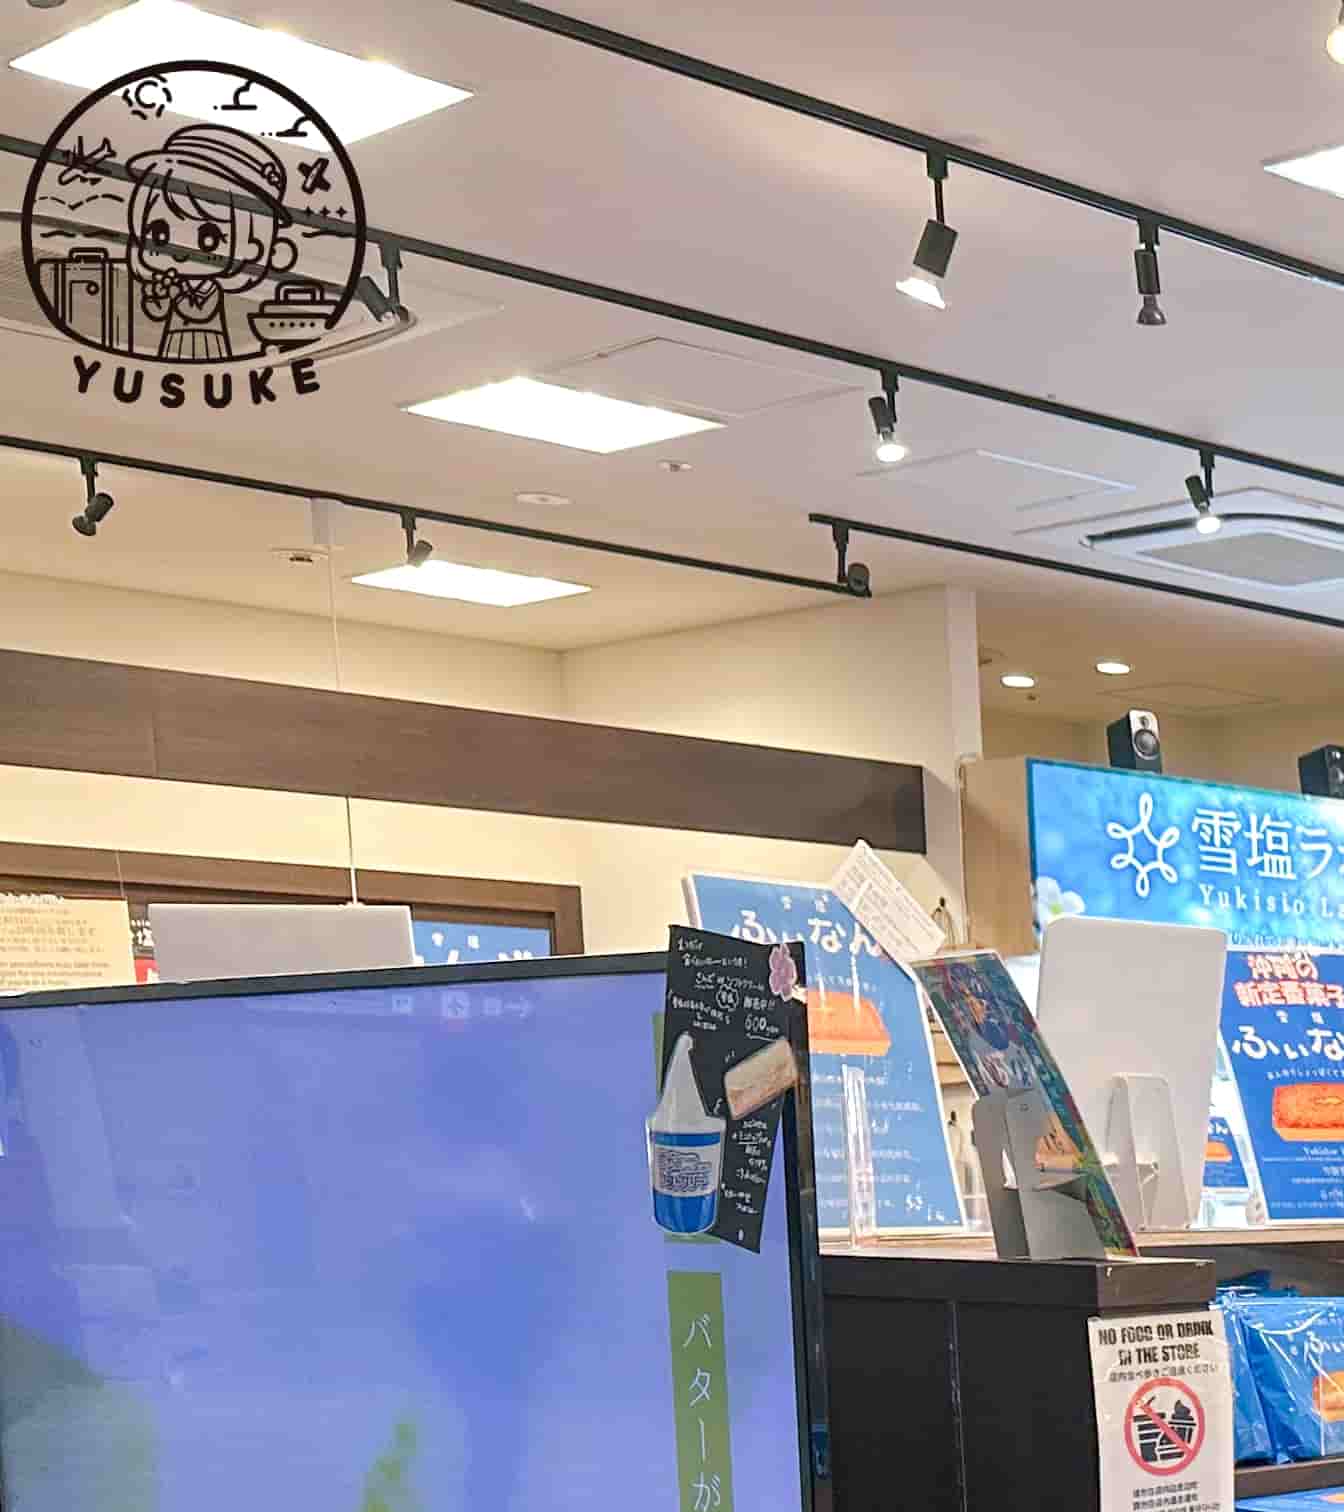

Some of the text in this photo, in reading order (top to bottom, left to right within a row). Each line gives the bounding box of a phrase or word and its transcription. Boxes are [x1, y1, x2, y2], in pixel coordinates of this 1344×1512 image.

[1199, 883, 1305, 915] Yukisio
[1098, 1319, 1214, 1346] NO FOOD OR DRINK
[1135, 1347, 1159, 1366] THE
[1161, 1342, 1201, 1364] STORE
